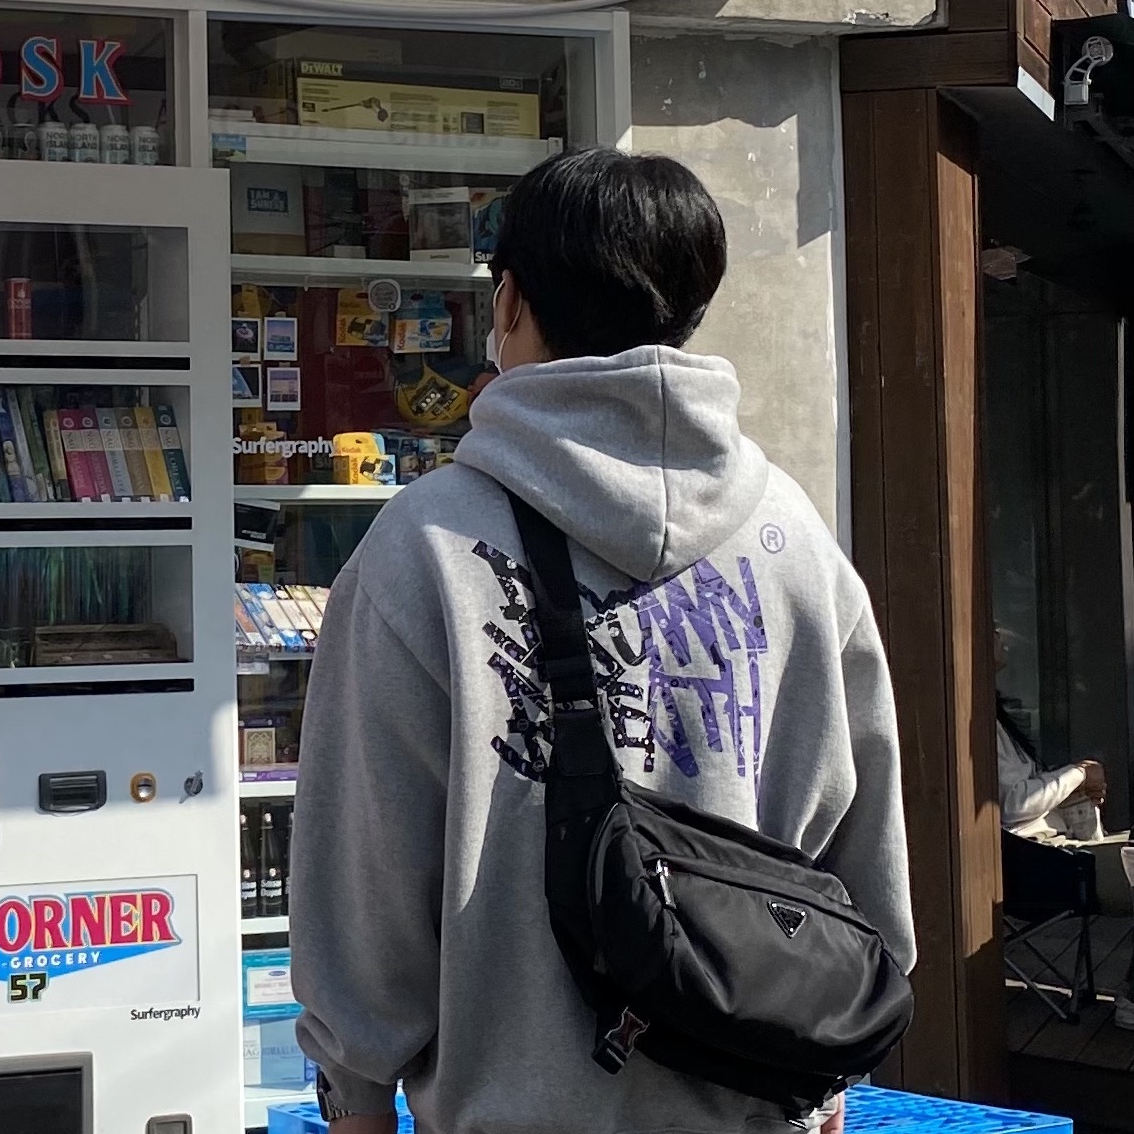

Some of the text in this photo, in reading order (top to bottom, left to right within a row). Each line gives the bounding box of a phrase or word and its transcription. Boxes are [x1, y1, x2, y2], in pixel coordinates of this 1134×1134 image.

[232, 436, 336, 459] Surfergraphy
[350, 456, 359, 484] Kodak
[6, 971, 49, 1004] 57
[130, 1004, 201, 1021] Surfergraphy
